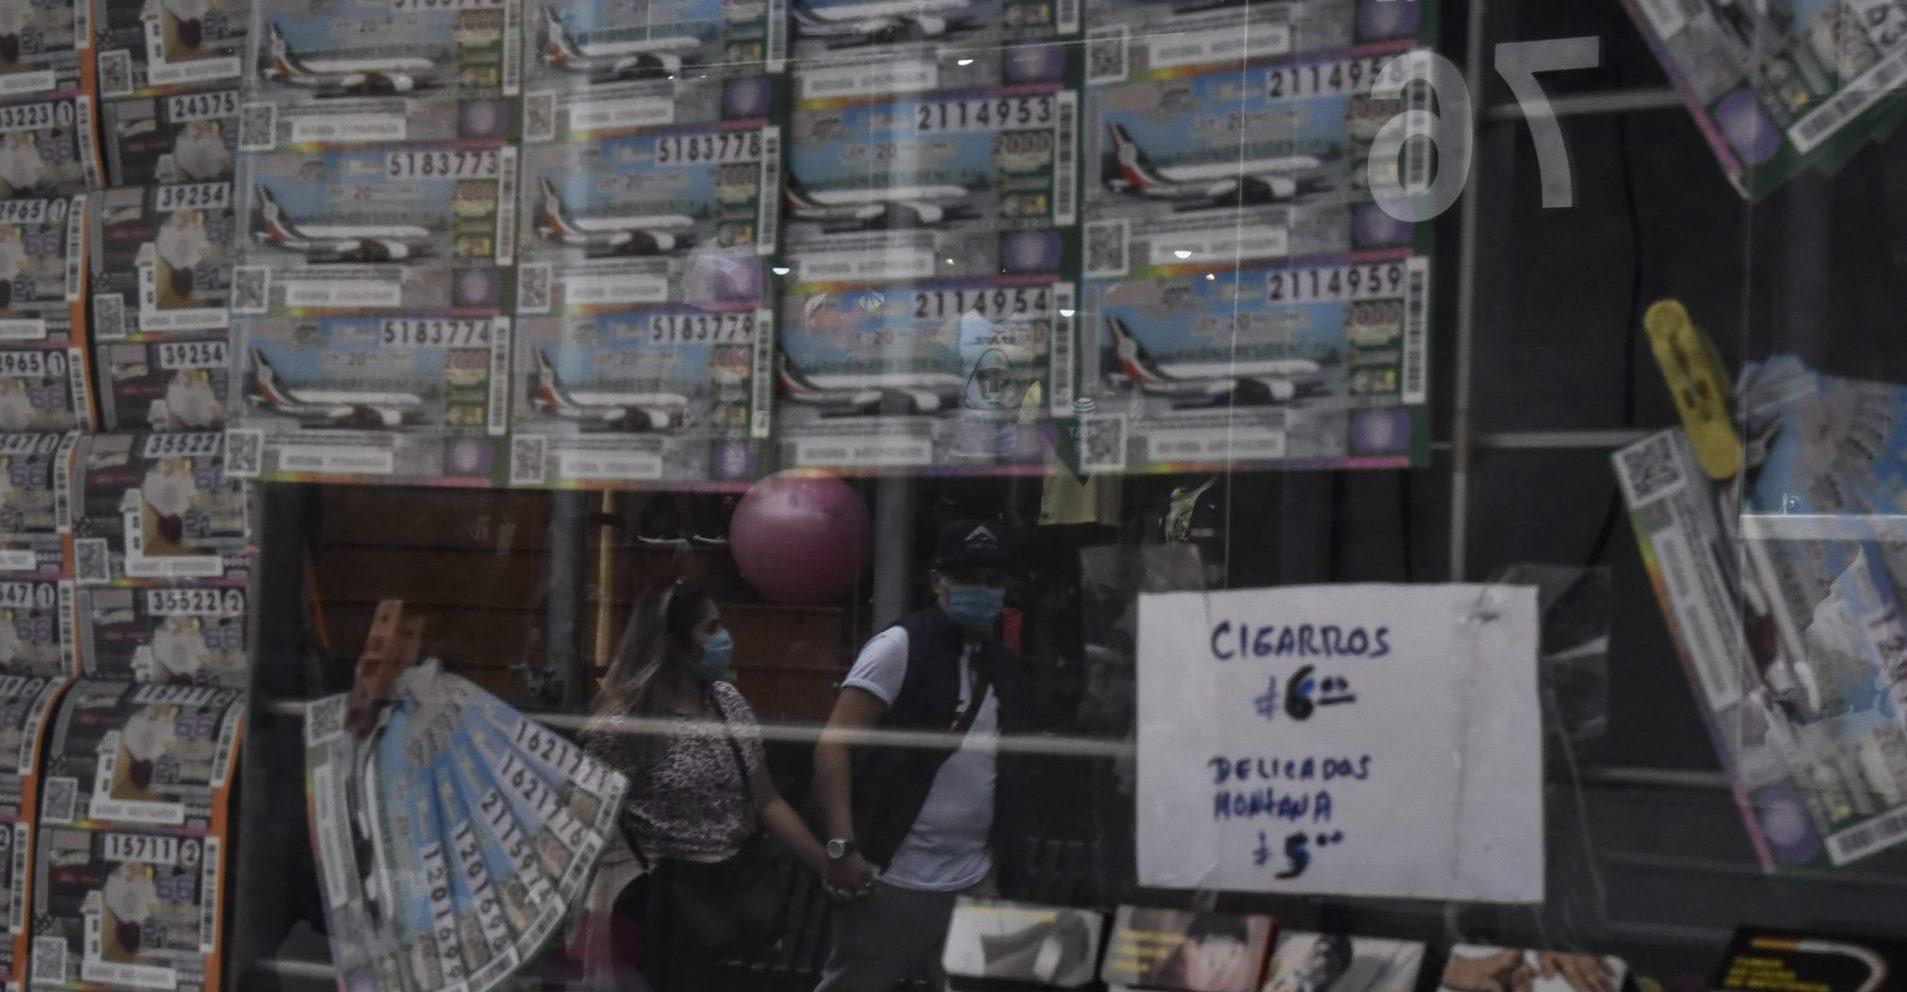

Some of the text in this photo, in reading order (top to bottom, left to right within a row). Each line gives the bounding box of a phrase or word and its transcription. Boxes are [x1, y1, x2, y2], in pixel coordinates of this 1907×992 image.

[0, 105, 49, 128] 3223
[174, 96, 235, 118] 24375
[917, 96, 1051, 131] 2114953
[388, 151, 498, 176] 5183773
[162, 189, 225, 208] 39254
[1268, 263, 1402, 302] 2114959
[914, 286, 1048, 319] 2114954
[383, 320, 491, 344] 5183774
[0, 353, 40, 372] 965
[165, 344, 224, 364] 39254
[0, 585, 28, 603] 47
[1210, 620, 1391, 661] CIGARROS
[110, 836, 172, 860] 15711
